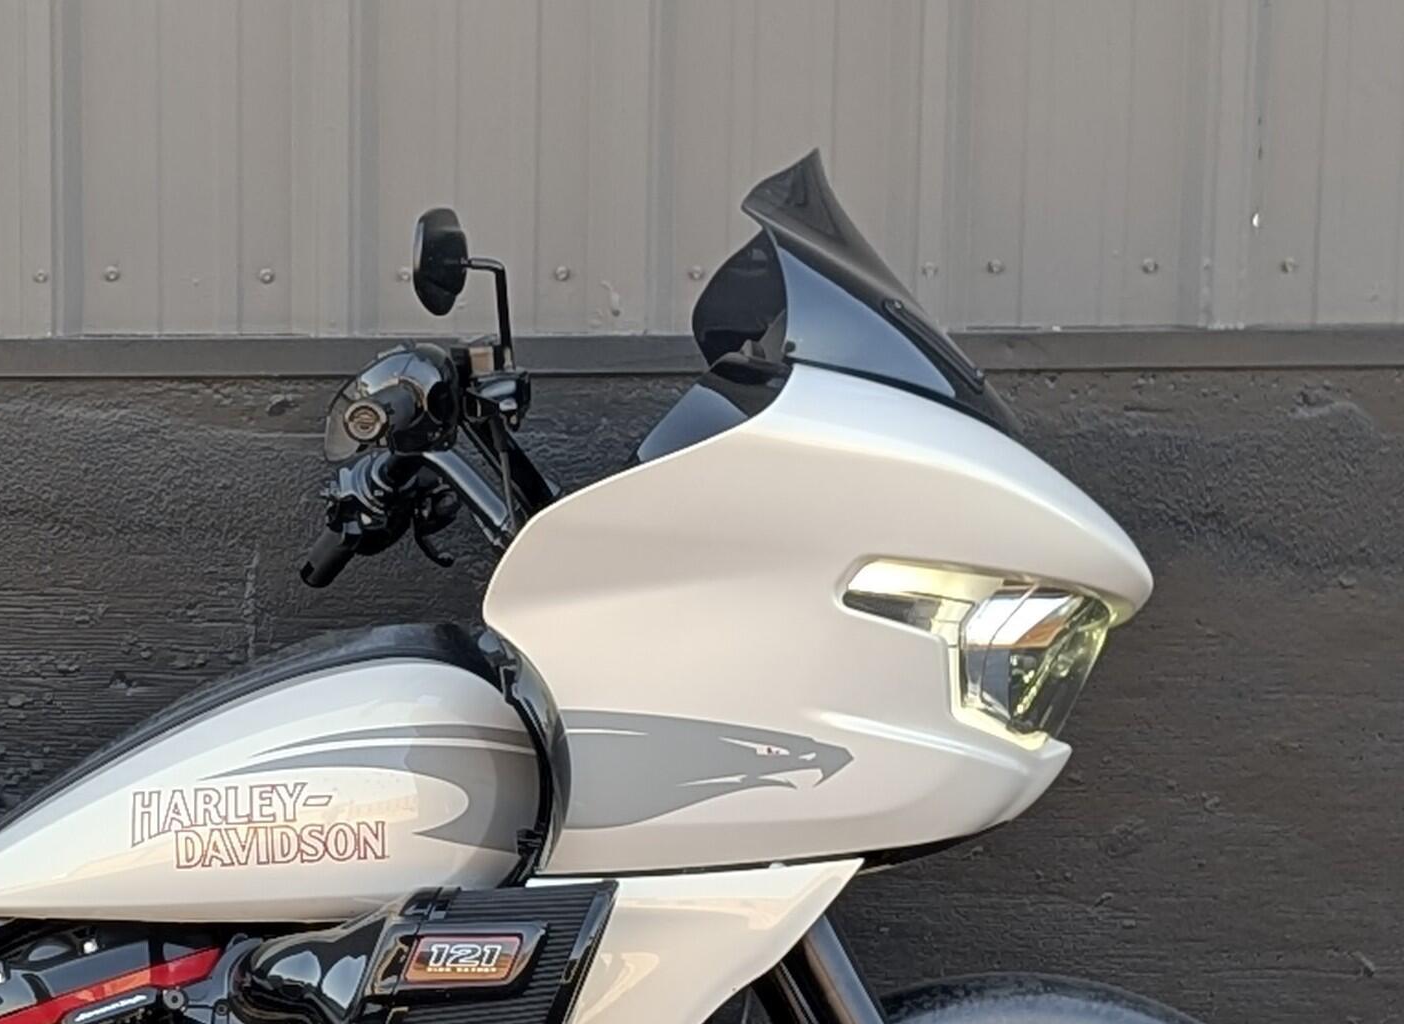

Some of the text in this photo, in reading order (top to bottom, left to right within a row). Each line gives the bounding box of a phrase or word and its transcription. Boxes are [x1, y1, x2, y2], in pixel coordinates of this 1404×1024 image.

[131, 782, 332, 848] HARLEY-
[175, 821, 386, 869] DAVIDSON
[429, 944, 502, 967] 121
